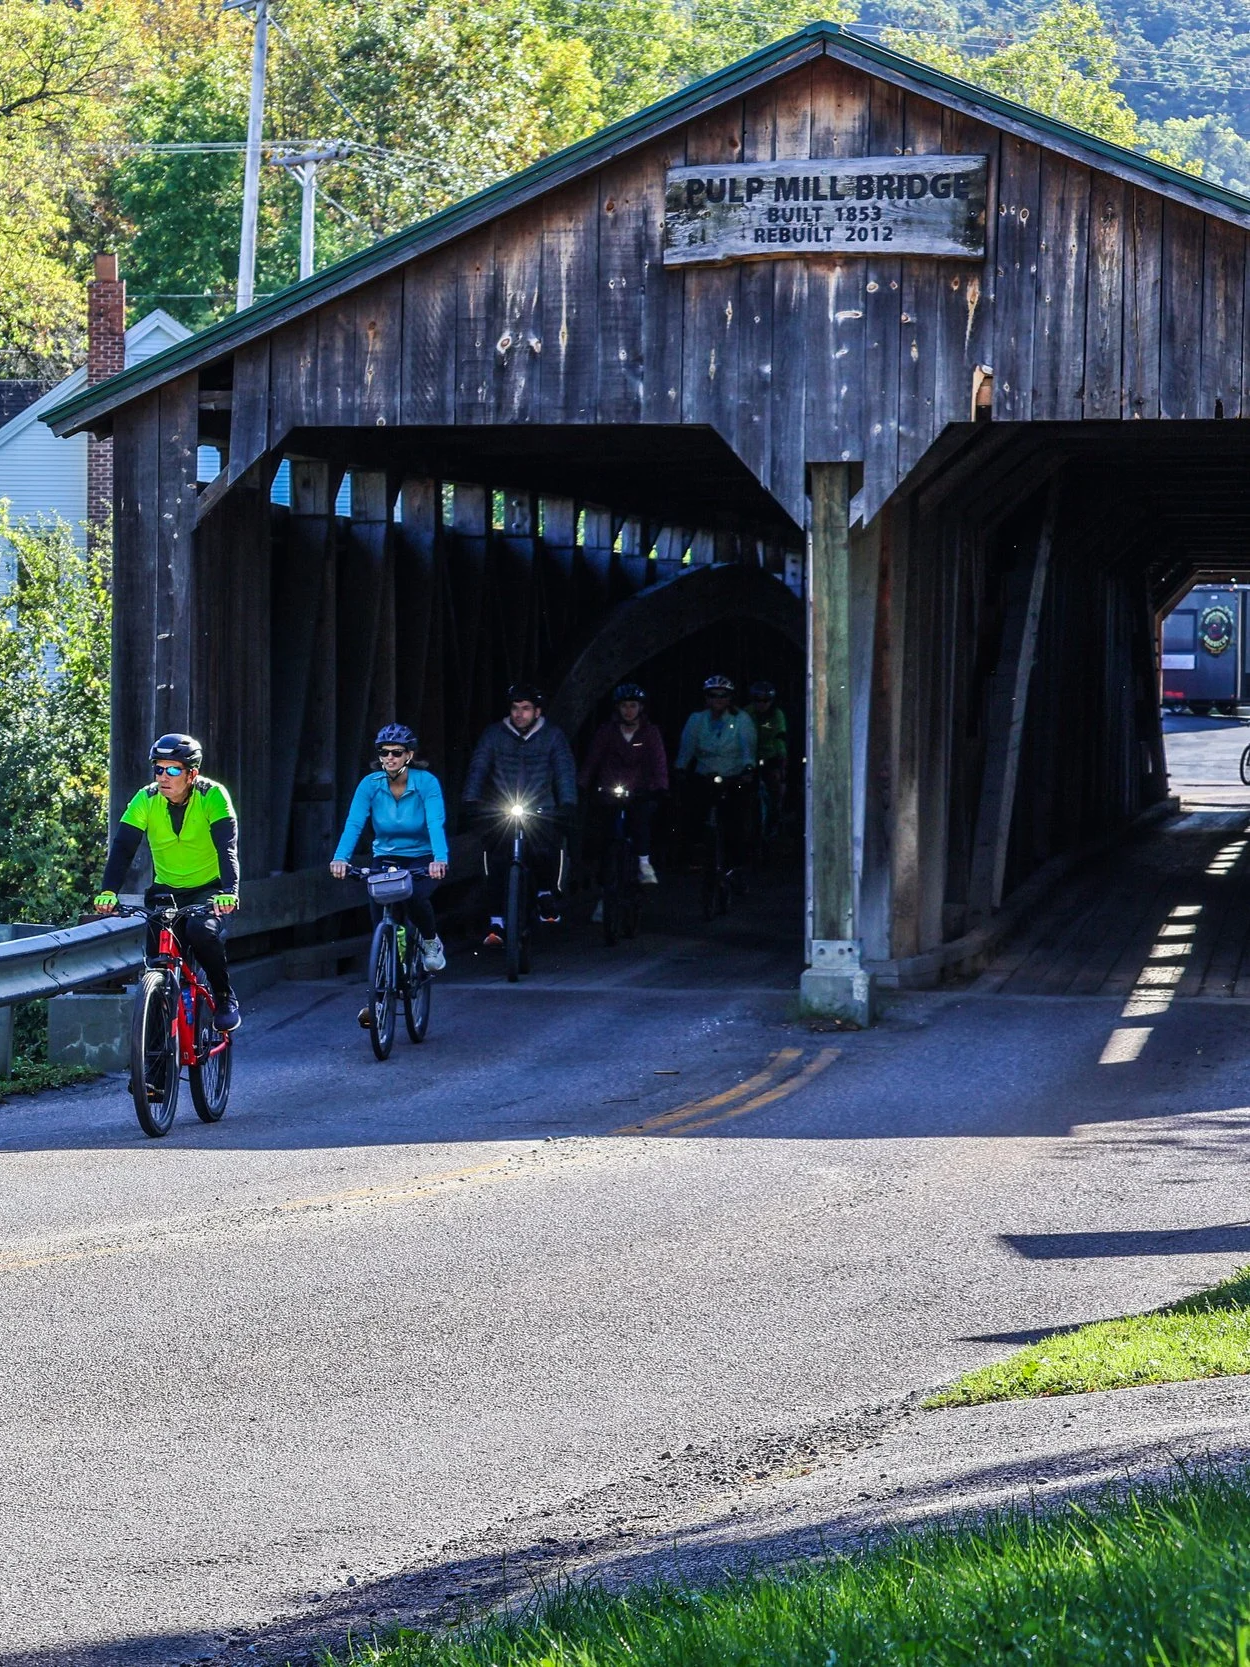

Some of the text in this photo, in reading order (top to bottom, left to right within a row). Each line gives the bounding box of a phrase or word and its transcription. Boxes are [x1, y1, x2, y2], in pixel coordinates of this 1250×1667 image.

[685, 173, 969, 204] PULP MILL BRIDGE
[768, 205, 882, 222] BUILT 1853
[754, 225, 893, 243] REBUILT 2012
